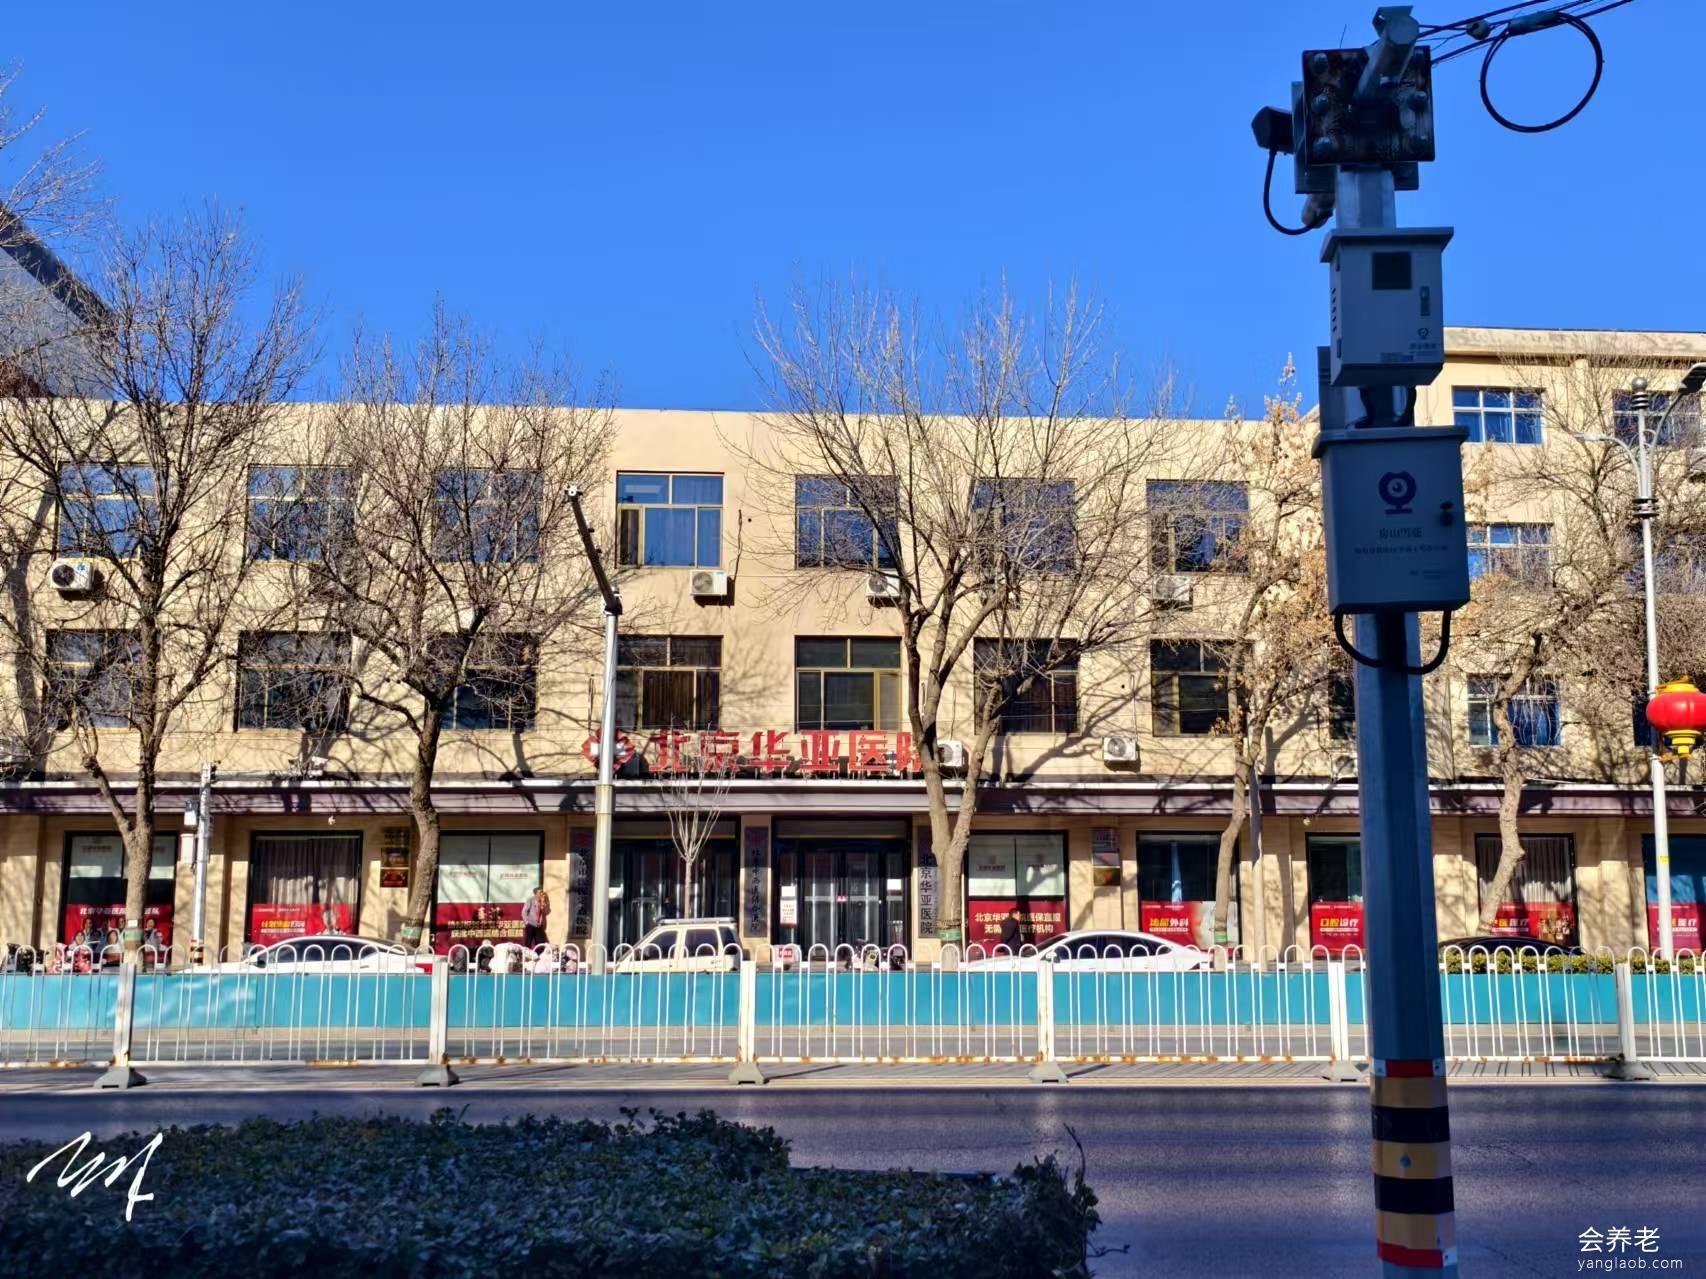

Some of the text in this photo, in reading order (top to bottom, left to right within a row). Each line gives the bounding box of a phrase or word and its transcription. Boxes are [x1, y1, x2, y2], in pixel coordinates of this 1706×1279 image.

[920, 855, 933, 934] 北京华亚医院
